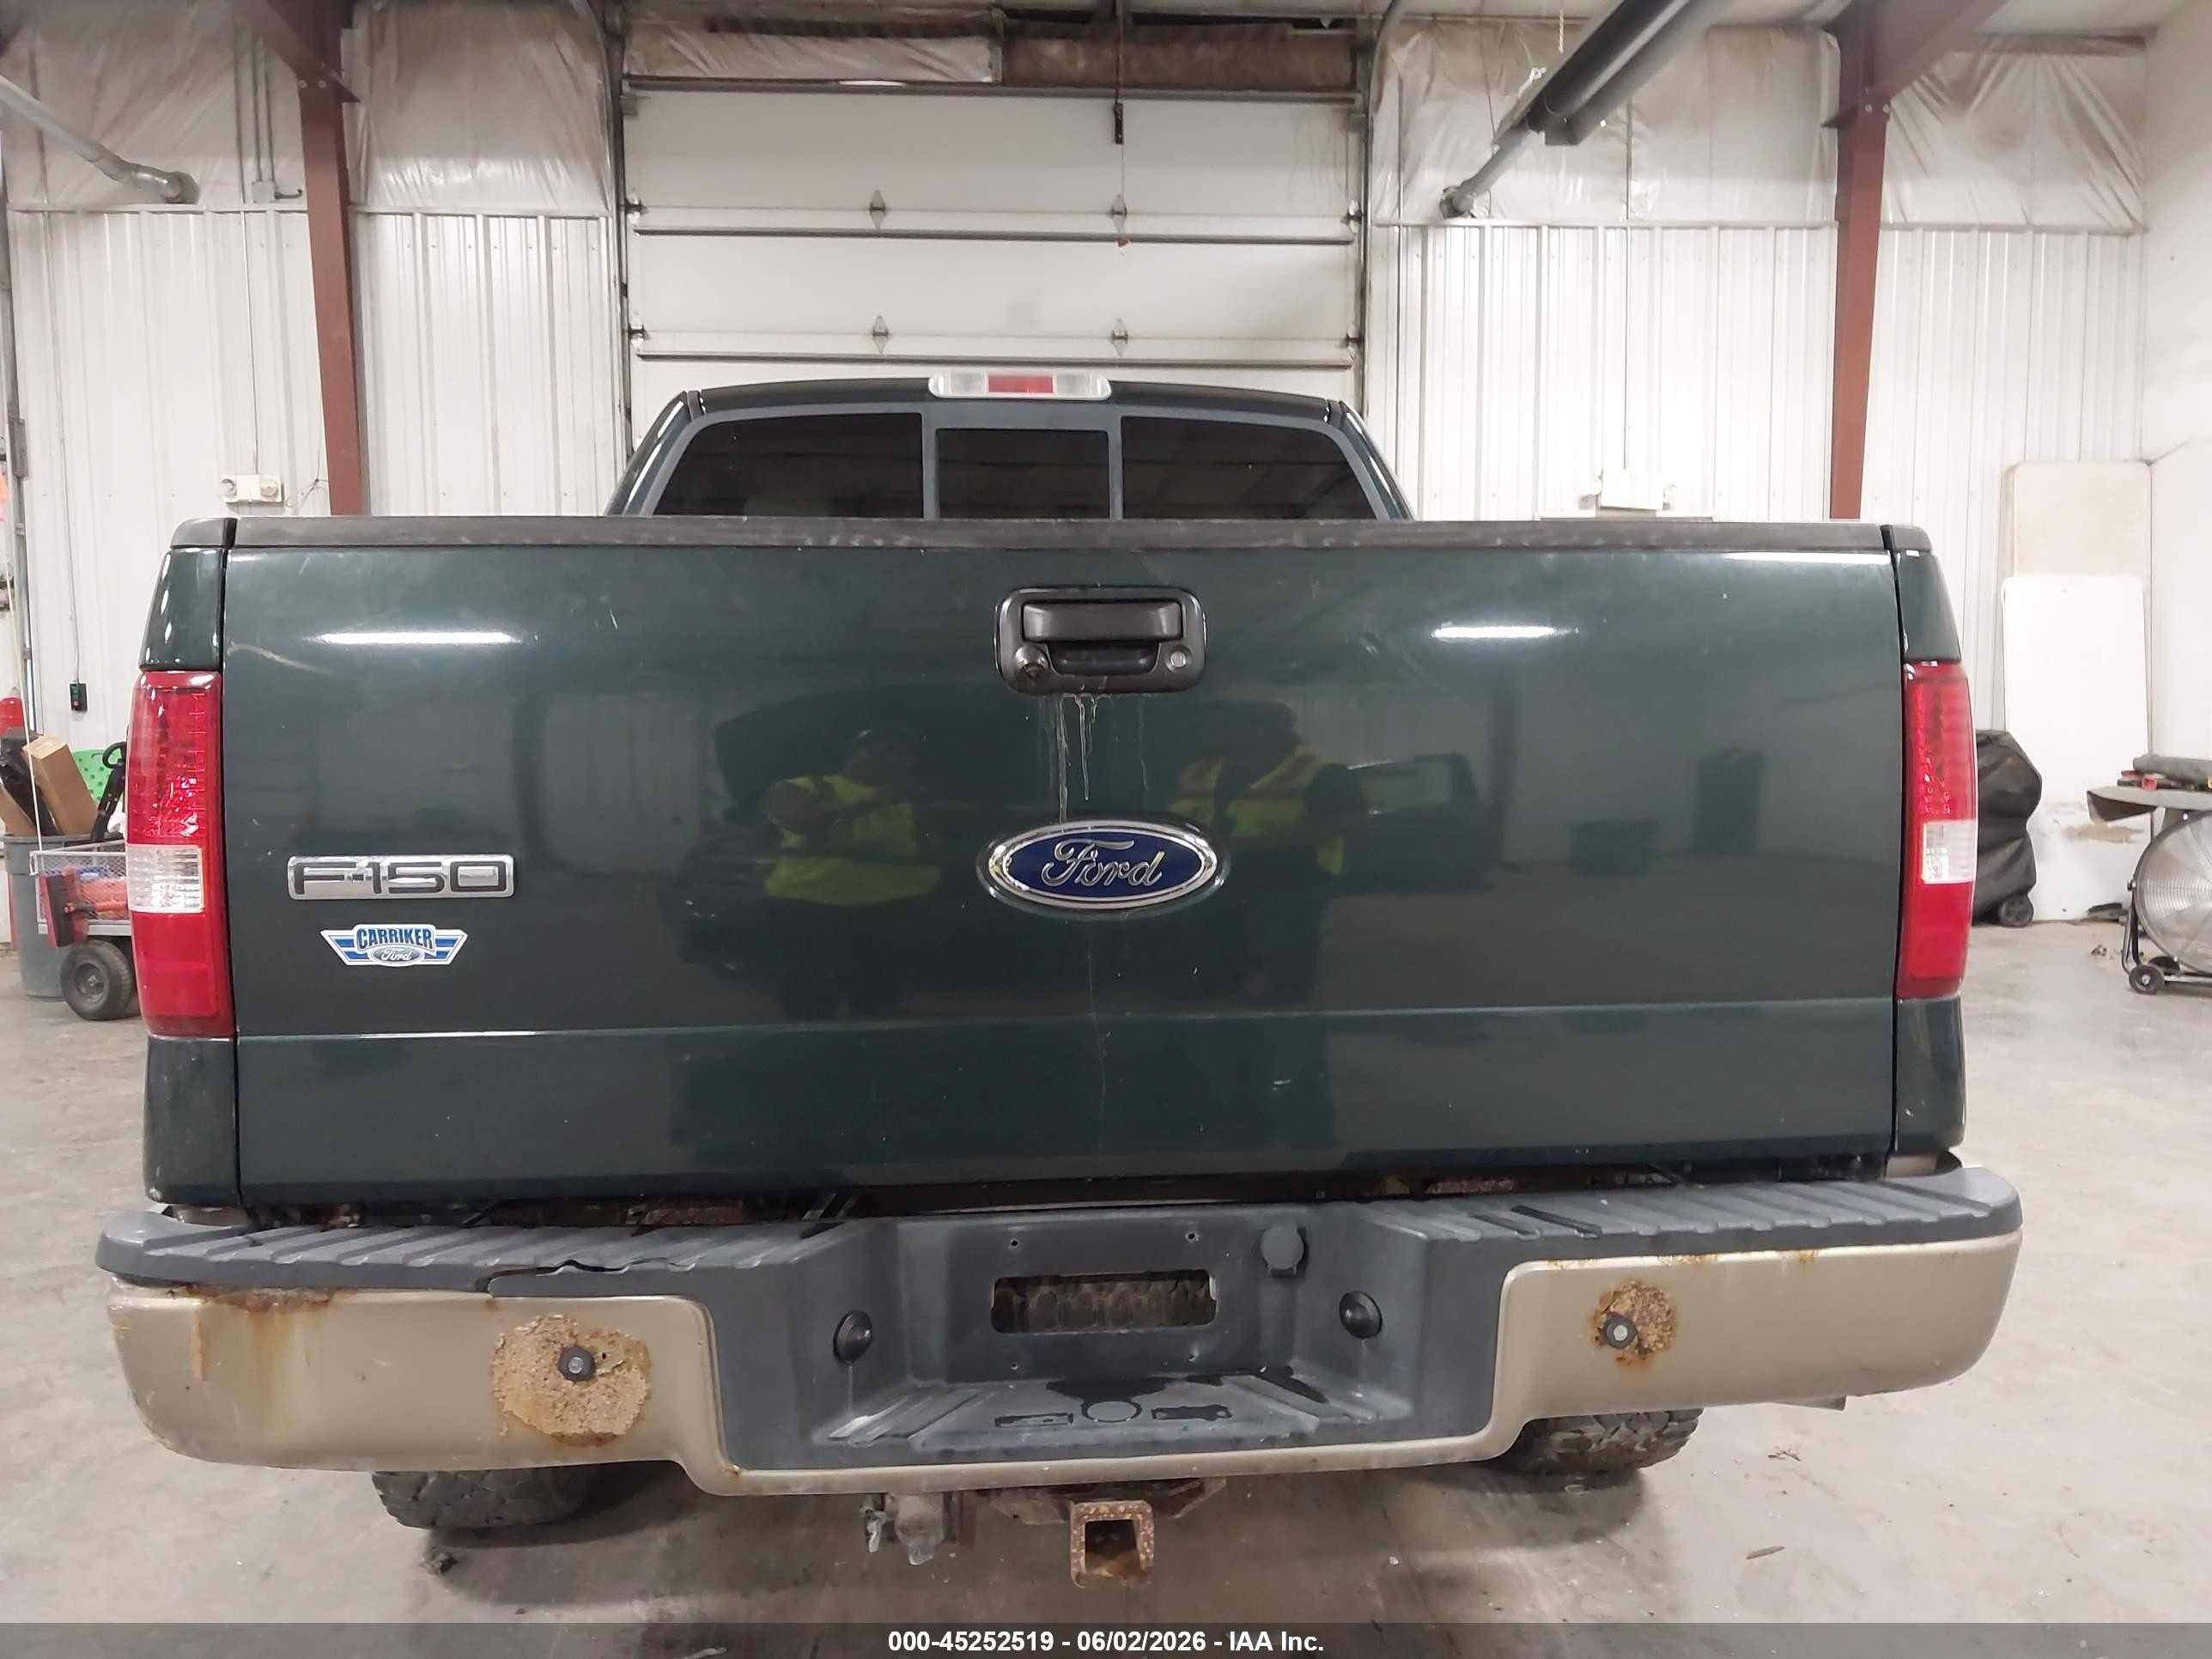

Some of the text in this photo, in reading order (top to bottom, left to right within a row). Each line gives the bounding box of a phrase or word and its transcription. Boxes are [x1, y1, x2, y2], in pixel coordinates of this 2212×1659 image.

[1041, 838, 1163, 886] Ford
[292, 860, 508, 896] F-150
[356, 927, 434, 950] CARRIKER
[378, 948, 413, 961] Ford
